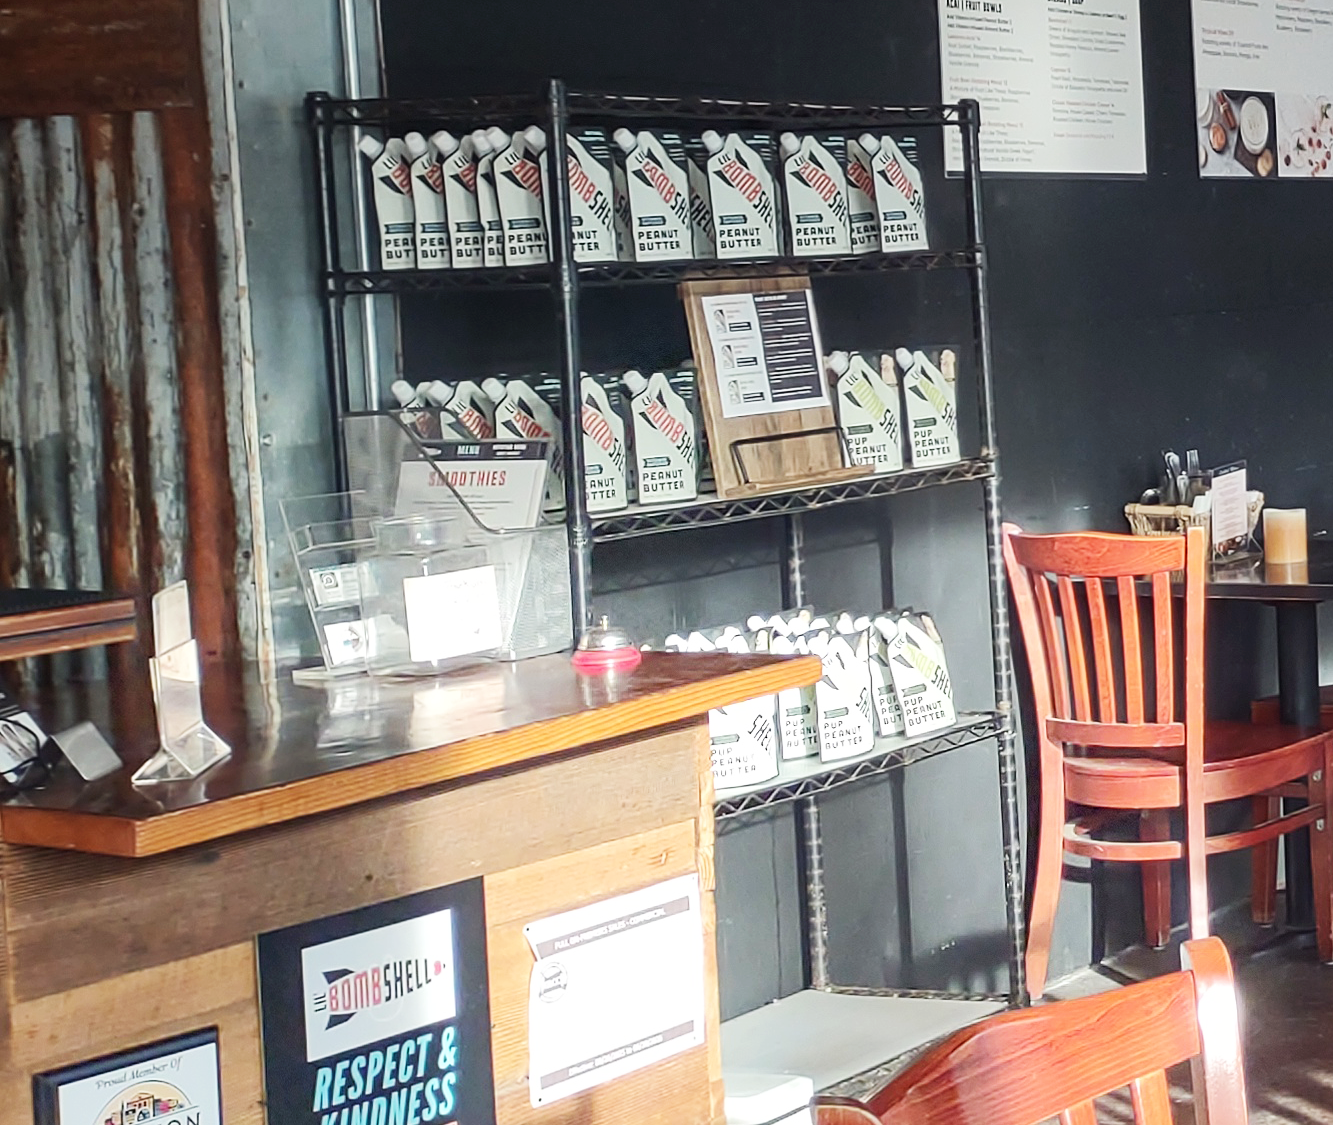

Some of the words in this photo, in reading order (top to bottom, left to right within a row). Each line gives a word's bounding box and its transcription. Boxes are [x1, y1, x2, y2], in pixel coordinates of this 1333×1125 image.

[719, 228, 760, 238] PEANUT
[796, 227, 835, 235] PEANUT
[883, 223, 917, 233] PEANUT
[638, 230, 679, 239] PEANUT
[885, 233, 919, 243] BUTTER
[639, 241, 680, 251] BUTTER
[721, 239, 761, 249] BUTTER
[797, 237, 836, 246] BUTTER
[914, 430, 932, 438] PUP
[915, 437, 949, 447] PEANUT
[643, 469, 683, 481] PEANUT
[644, 480, 684, 492] BUTTER
[904, 696, 923, 707] PUP
[906, 700, 942, 716] PEANUT
[908, 711, 946, 726] BUTTER
[824, 720, 843, 729] PUP
[824, 726, 862, 740] PEANUT
[826, 736, 863, 750] BUTTER
[329, 958, 432, 1012] BOMBSHELL
[96, 1075, 126, 1090] Proud
[129, 1063, 167, 1080] Member
[170, 1056, 183, 1070] Of
[313, 1033, 433, 1112] RESPECT
[437, 1026, 458, 1070] &
